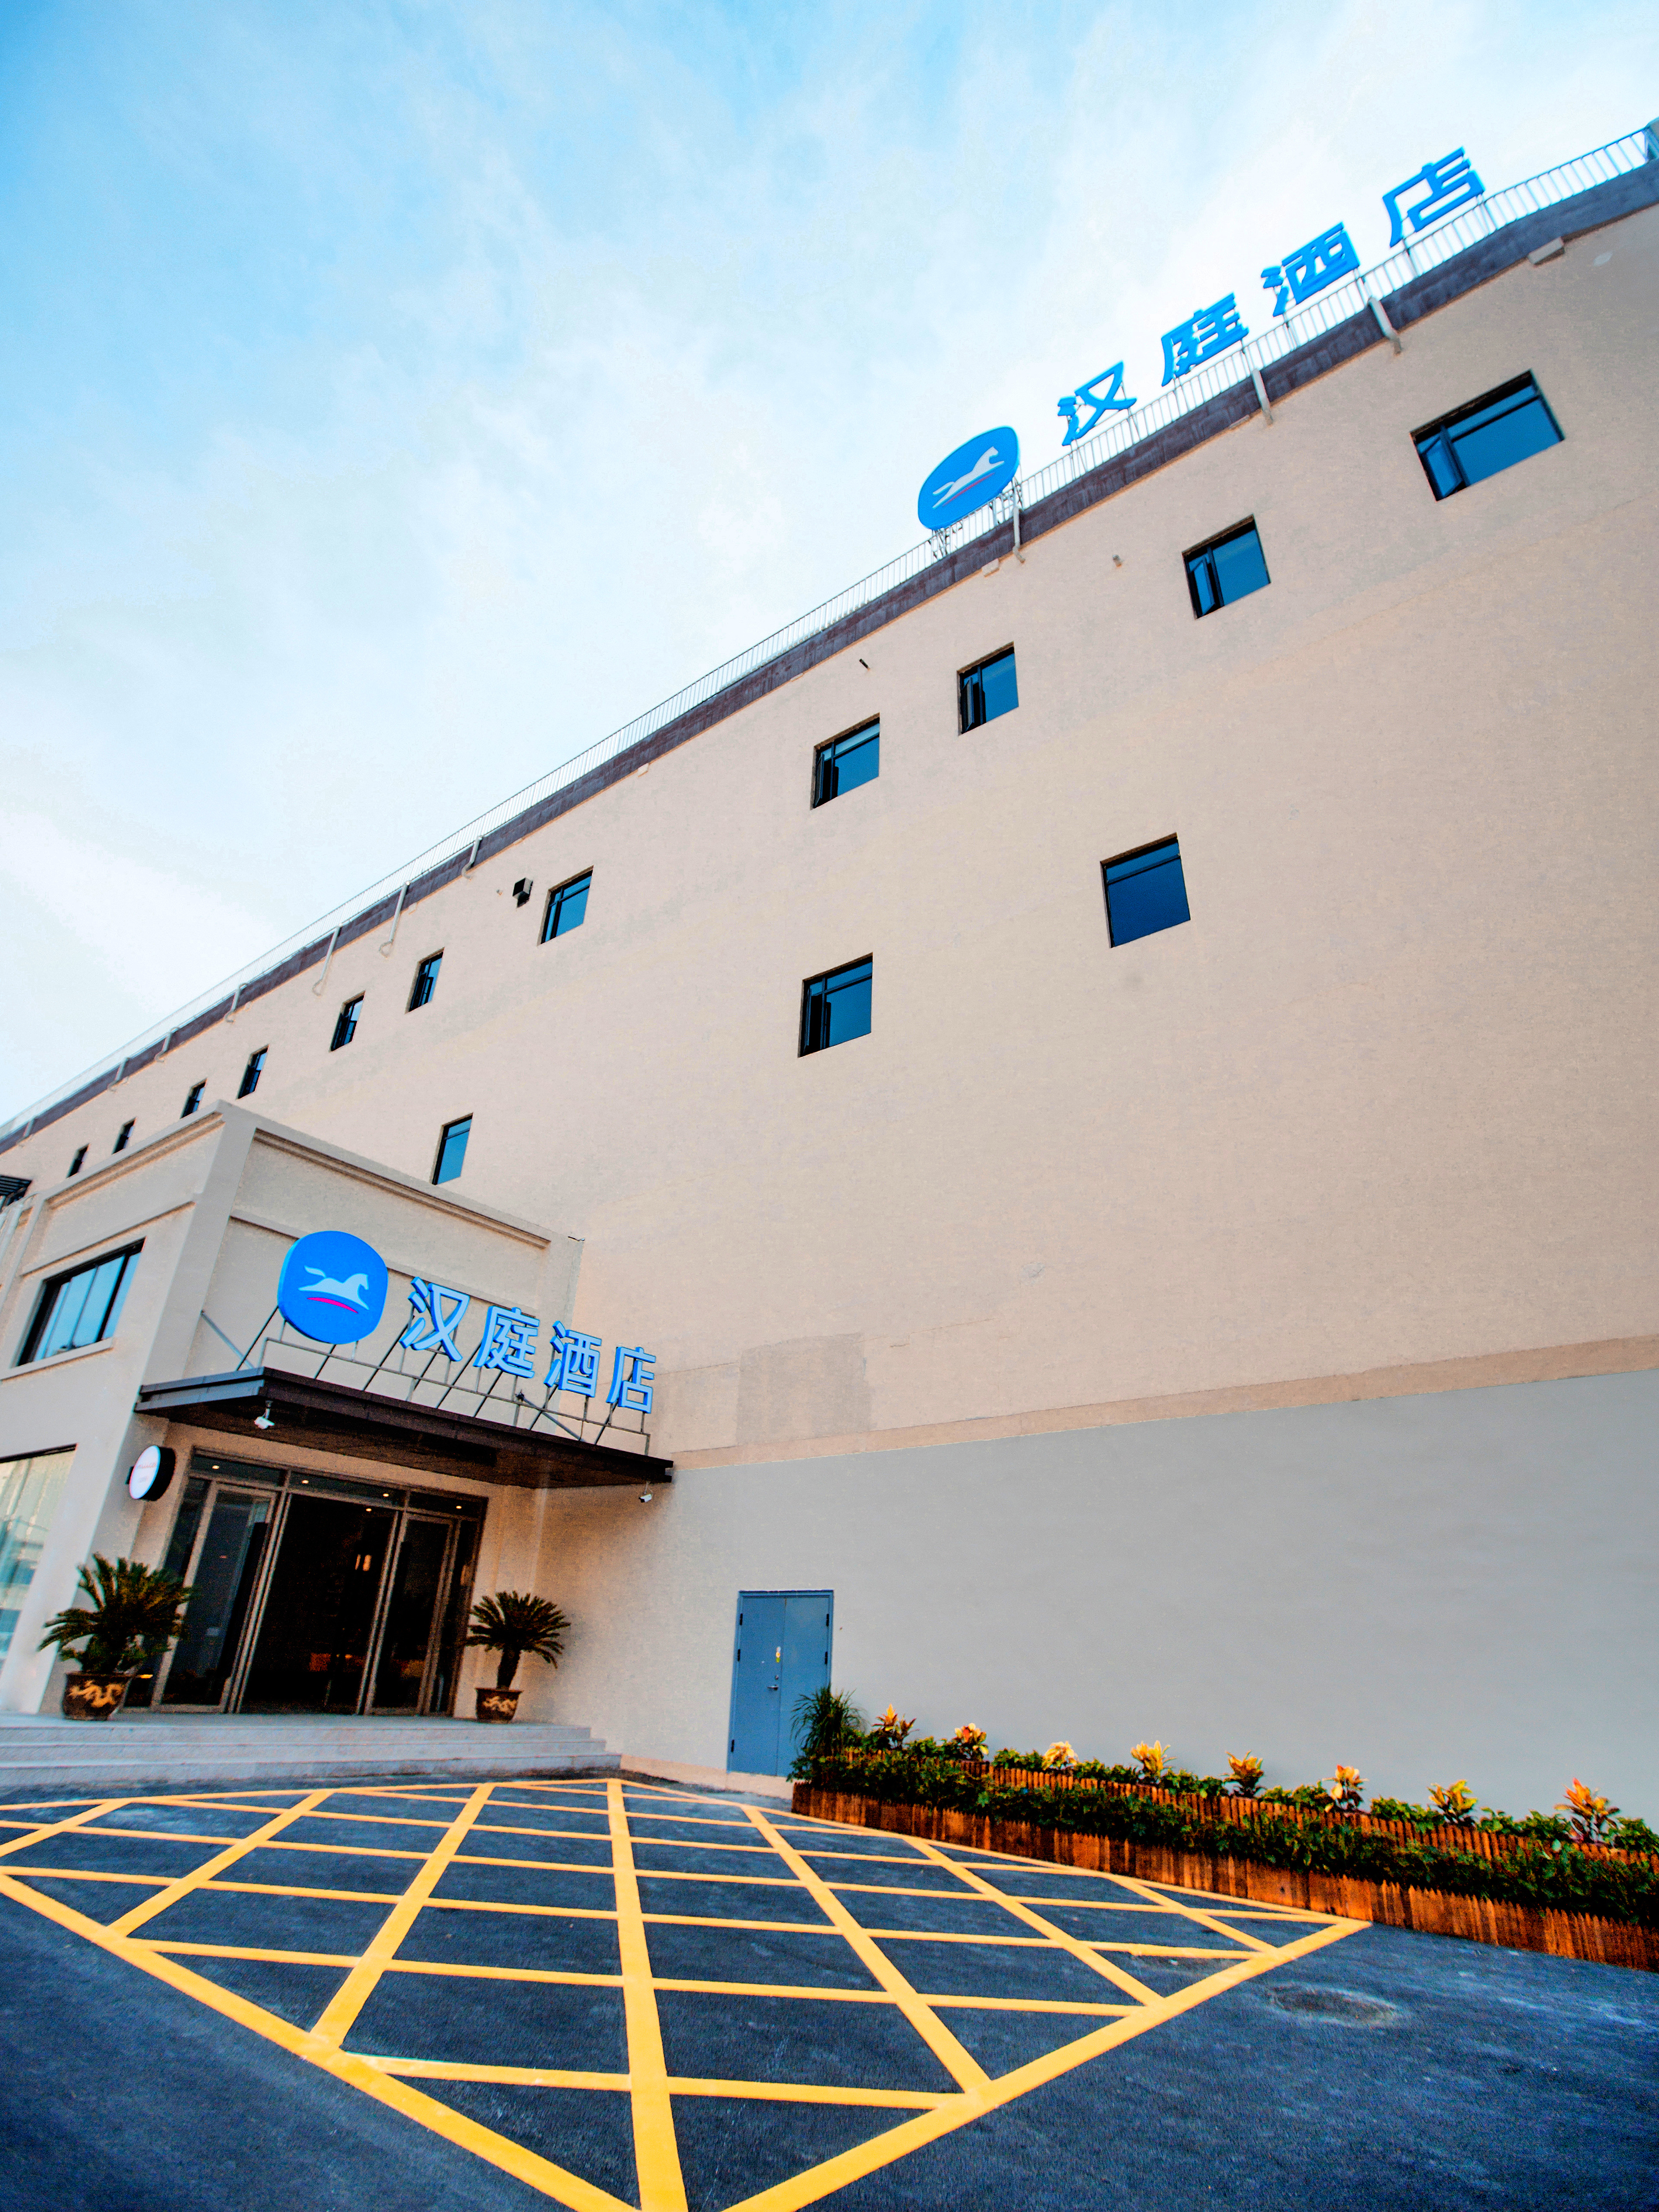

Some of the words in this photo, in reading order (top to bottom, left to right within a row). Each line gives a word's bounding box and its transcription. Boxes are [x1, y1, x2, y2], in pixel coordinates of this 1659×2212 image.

[1057, 146, 1486, 446] 汉庭酒店
[400, 1276, 656, 1414] 汉庭酒店
